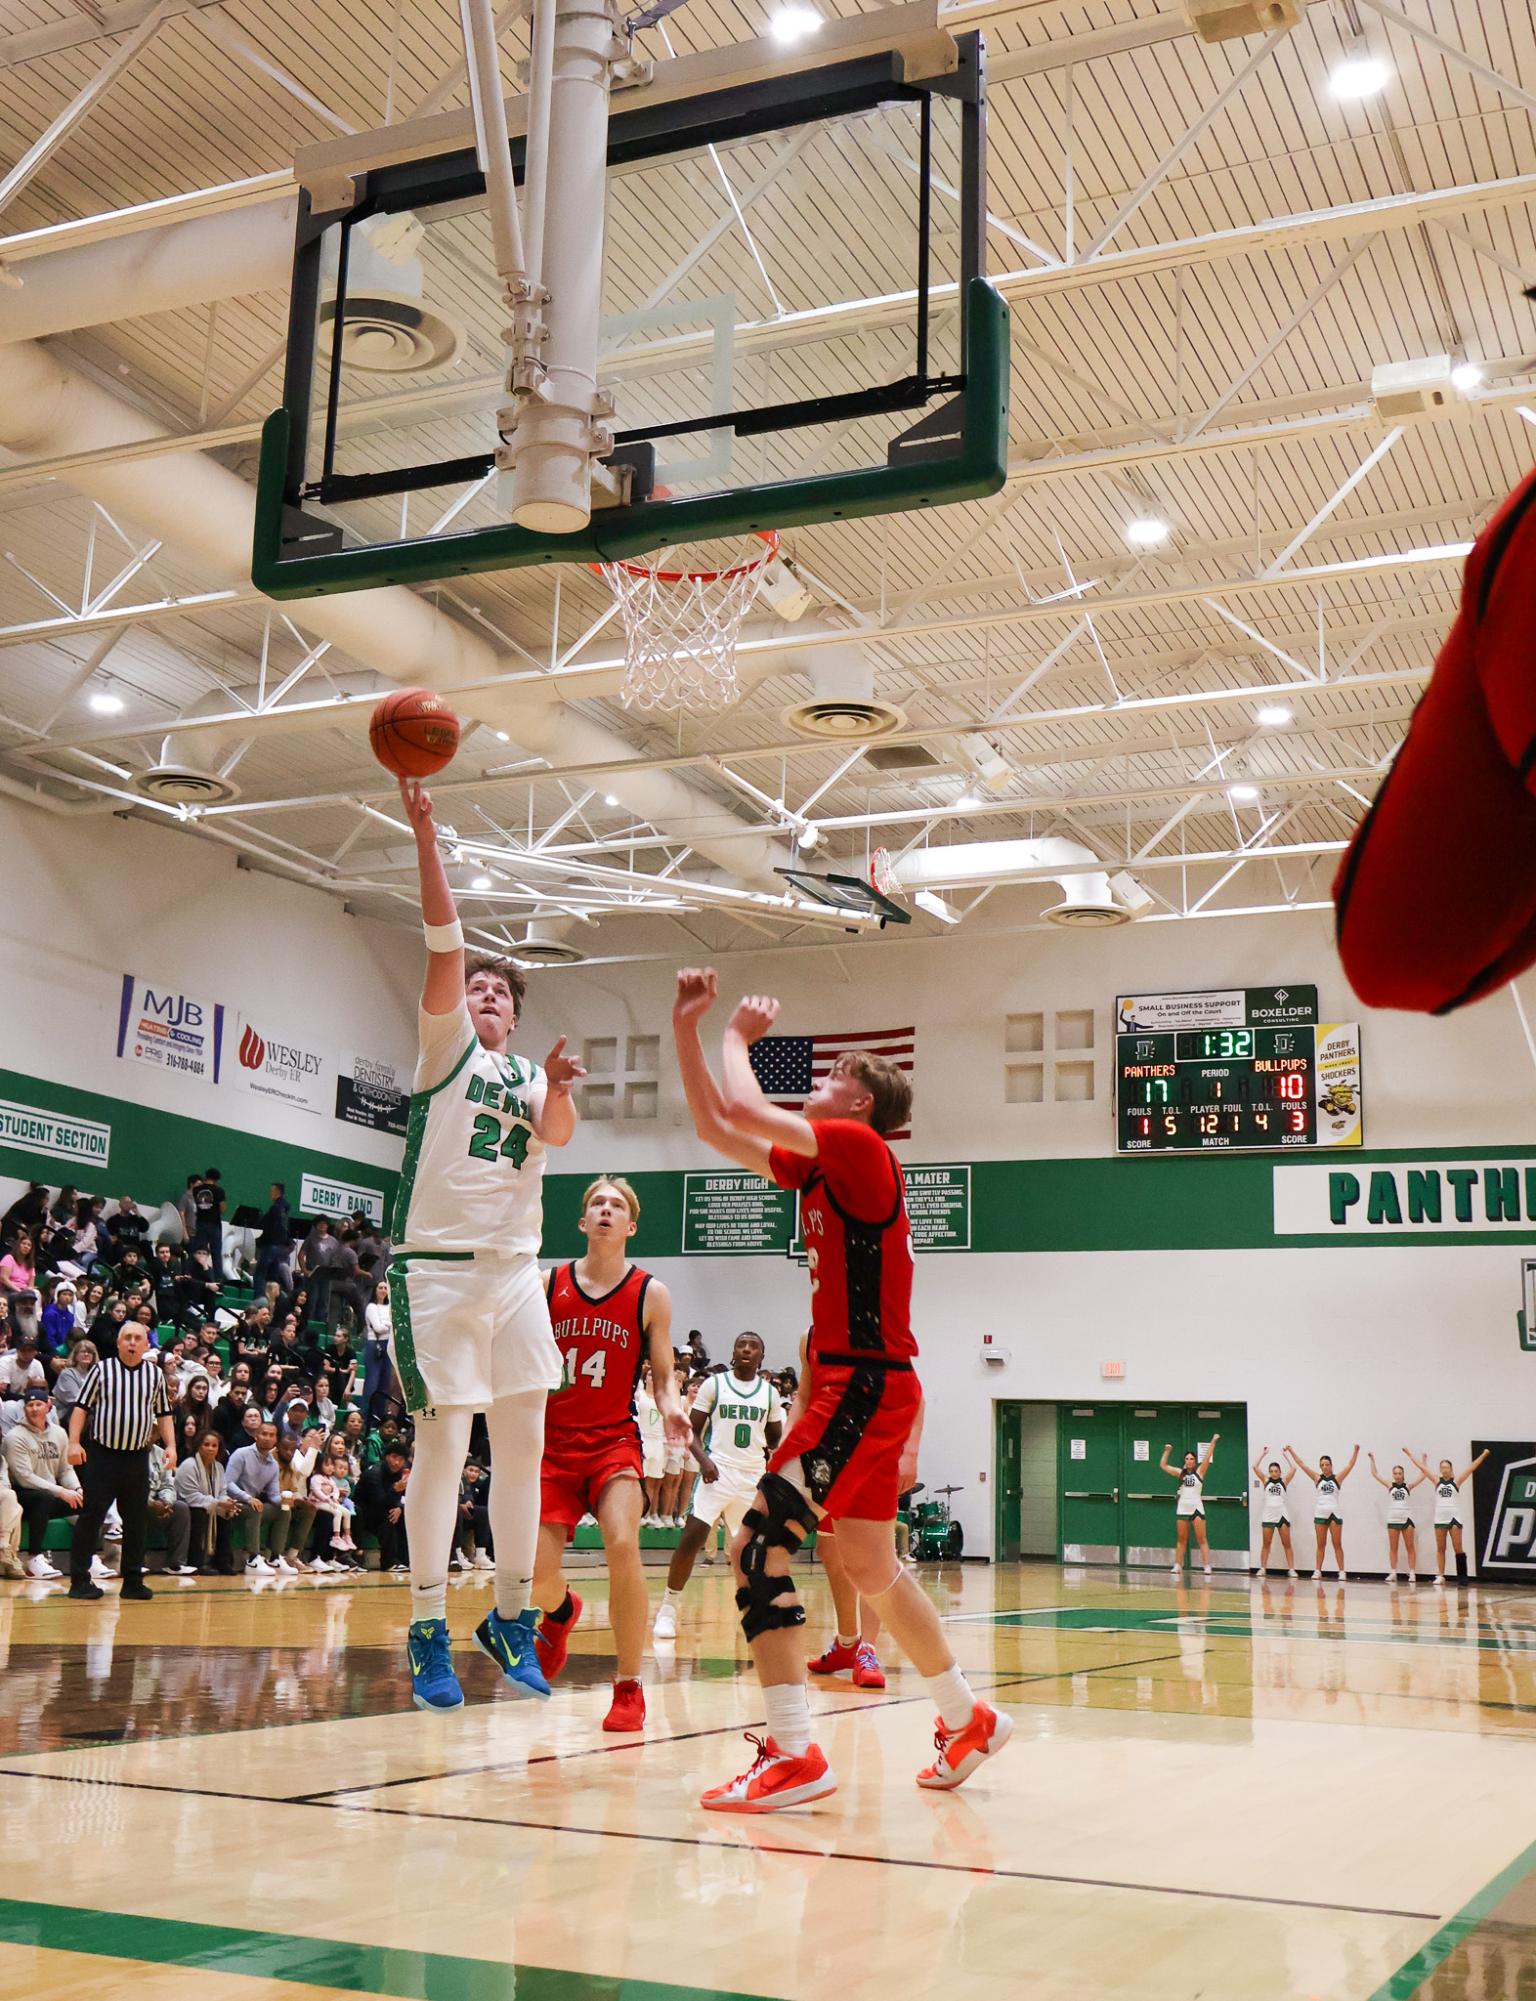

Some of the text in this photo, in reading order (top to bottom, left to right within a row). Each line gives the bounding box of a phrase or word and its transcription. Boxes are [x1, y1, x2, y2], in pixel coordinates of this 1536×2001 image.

[144, 990, 202, 1026] MJB
[1166, 1002, 1202, 1010] BUSINESS
[1204, 1000, 1241, 1008] SUPPORT
[1251, 1006, 1312, 1018] BOXELDER
[1205, 1031, 1250, 1057] 1:32
[1327, 1040, 1349, 1051] DERBY
[267, 1041, 322, 1075] WESLEY
[1320, 1048, 1356, 1061] PANTHERS
[266, 1061, 301, 1082] Derby ER
[1124, 1064, 1176, 1078] PANTHERS
[1201, 1069, 1229, 1077] PERIOD
[1255, 1059, 1307, 1072] BULLPUPS
[1321, 1067, 1356, 1081] SHOCKERS
[354, 1066, 394, 1088] DENTISTRY
[1281, 1074, 1303, 1098] 10
[1146, 1080, 1167, 1102] 17
[1216, 1082, 1221, 1098] 1
[1127, 1108, 1152, 1116] FOULS
[1190, 1105, 1220, 1113] PLAYER
[1223, 1104, 1243, 1112] FOUL
[1281, 1102, 1307, 1110] FOULS
[1144, 1116, 1176, 1135] 1 5
[1201, 1115, 1239, 1134] 12 1
[1255, 1112, 1304, 1131] 4 3
[0, 1114, 106, 1154] STUDENT SECTION
[468, 1113, 532, 1170] 24
[1127, 1135, 1307, 1148] SCORE MATCH SCORE
[705, 1178, 768, 1190] DERBY HIGH
[915, 1172, 950, 1184] MATER
[312, 1188, 372, 1214] DERBY BAND
[555, 1316, 629, 1348] BULLPUPS
[566, 1347, 606, 1388] 14
[719, 1404, 767, 1422] DERBY
[735, 1423, 751, 1448] 0
